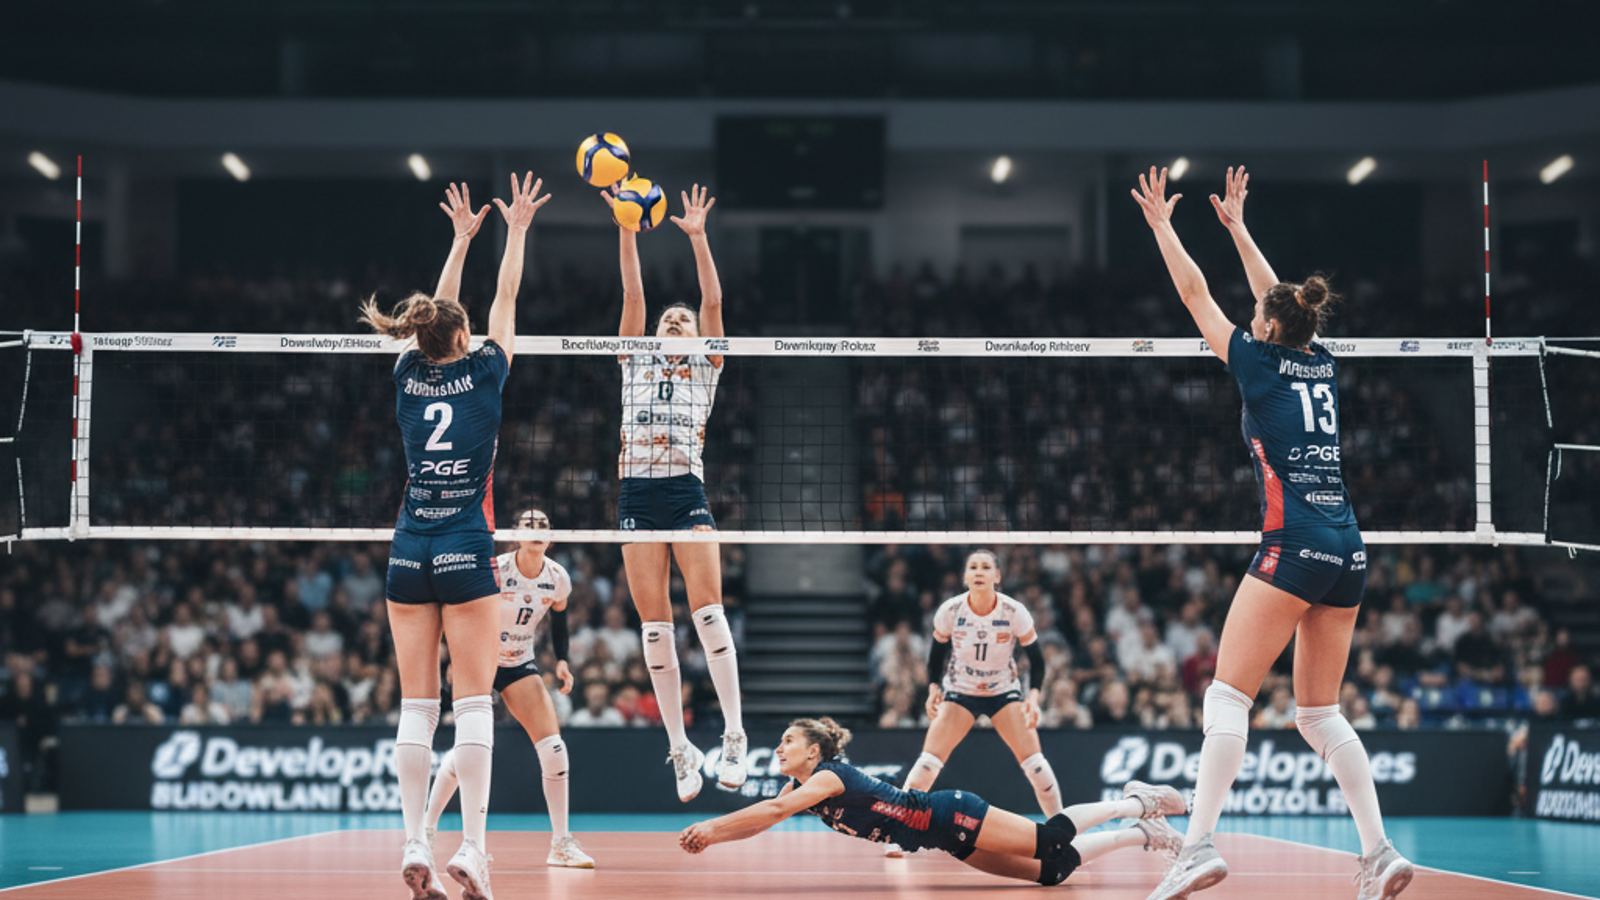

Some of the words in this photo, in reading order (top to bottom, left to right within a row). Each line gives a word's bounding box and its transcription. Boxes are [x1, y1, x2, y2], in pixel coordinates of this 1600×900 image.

[423, 401, 454, 451] 2
[1291, 382, 1337, 435] 13
[420, 459, 471, 476] PGE
[973, 642, 988, 662] 11
[1150, 739, 1417, 791] Deelopes
